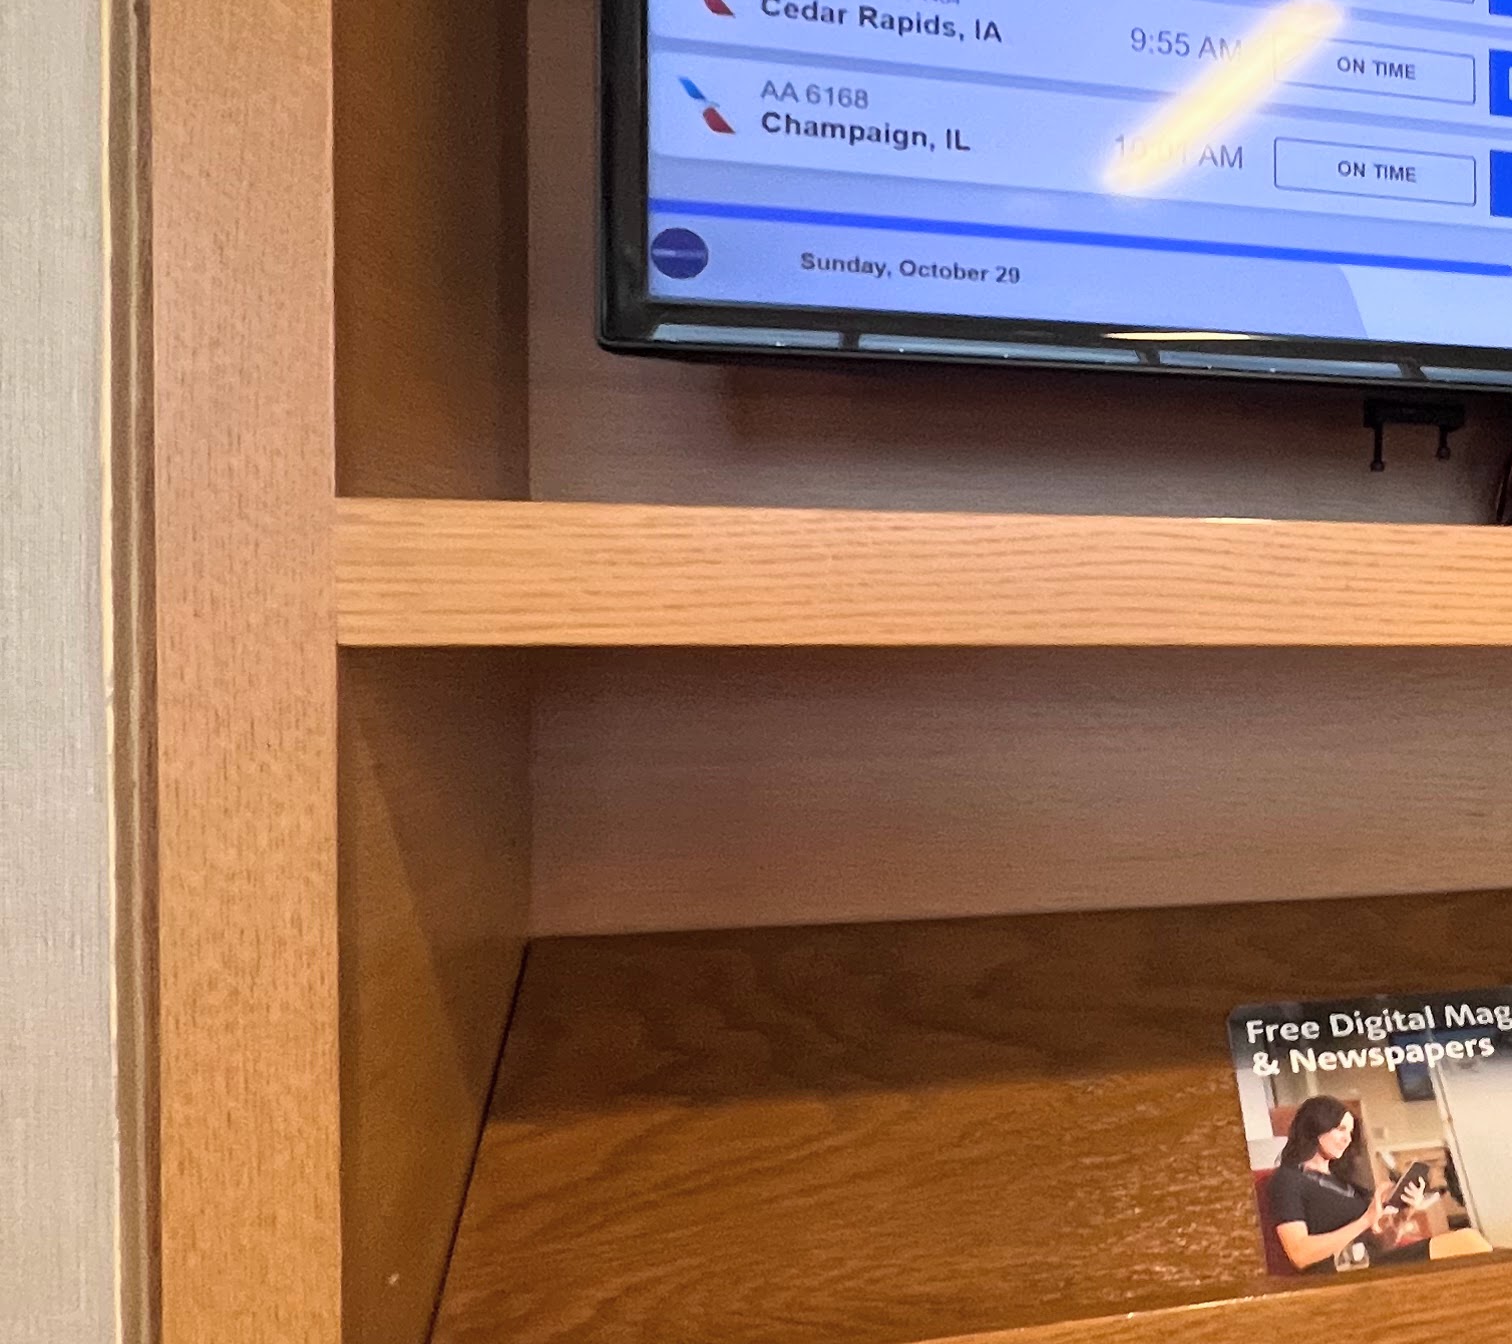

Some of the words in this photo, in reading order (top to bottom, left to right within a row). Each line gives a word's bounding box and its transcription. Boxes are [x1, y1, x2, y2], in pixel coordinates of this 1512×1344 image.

[858, 4, 965, 43] Rapids,
[974, 18, 1002, 44] IA
[760, 79, 798, 106] AA
[806, 83, 869, 109] 6168
[761, 111, 935, 152] Champaign,
[945, 128, 971, 152] IL
[801, 251, 892, 280] Sunday,
[899, 258, 989, 283] October
[995, 264, 1020, 285] 29
[1245, 1018, 1320, 1044] Free
[1329, 1005, 1435, 1041] Digital
[1252, 1052, 1281, 1077] &
[1290, 1035, 1496, 1074] Newspapers
